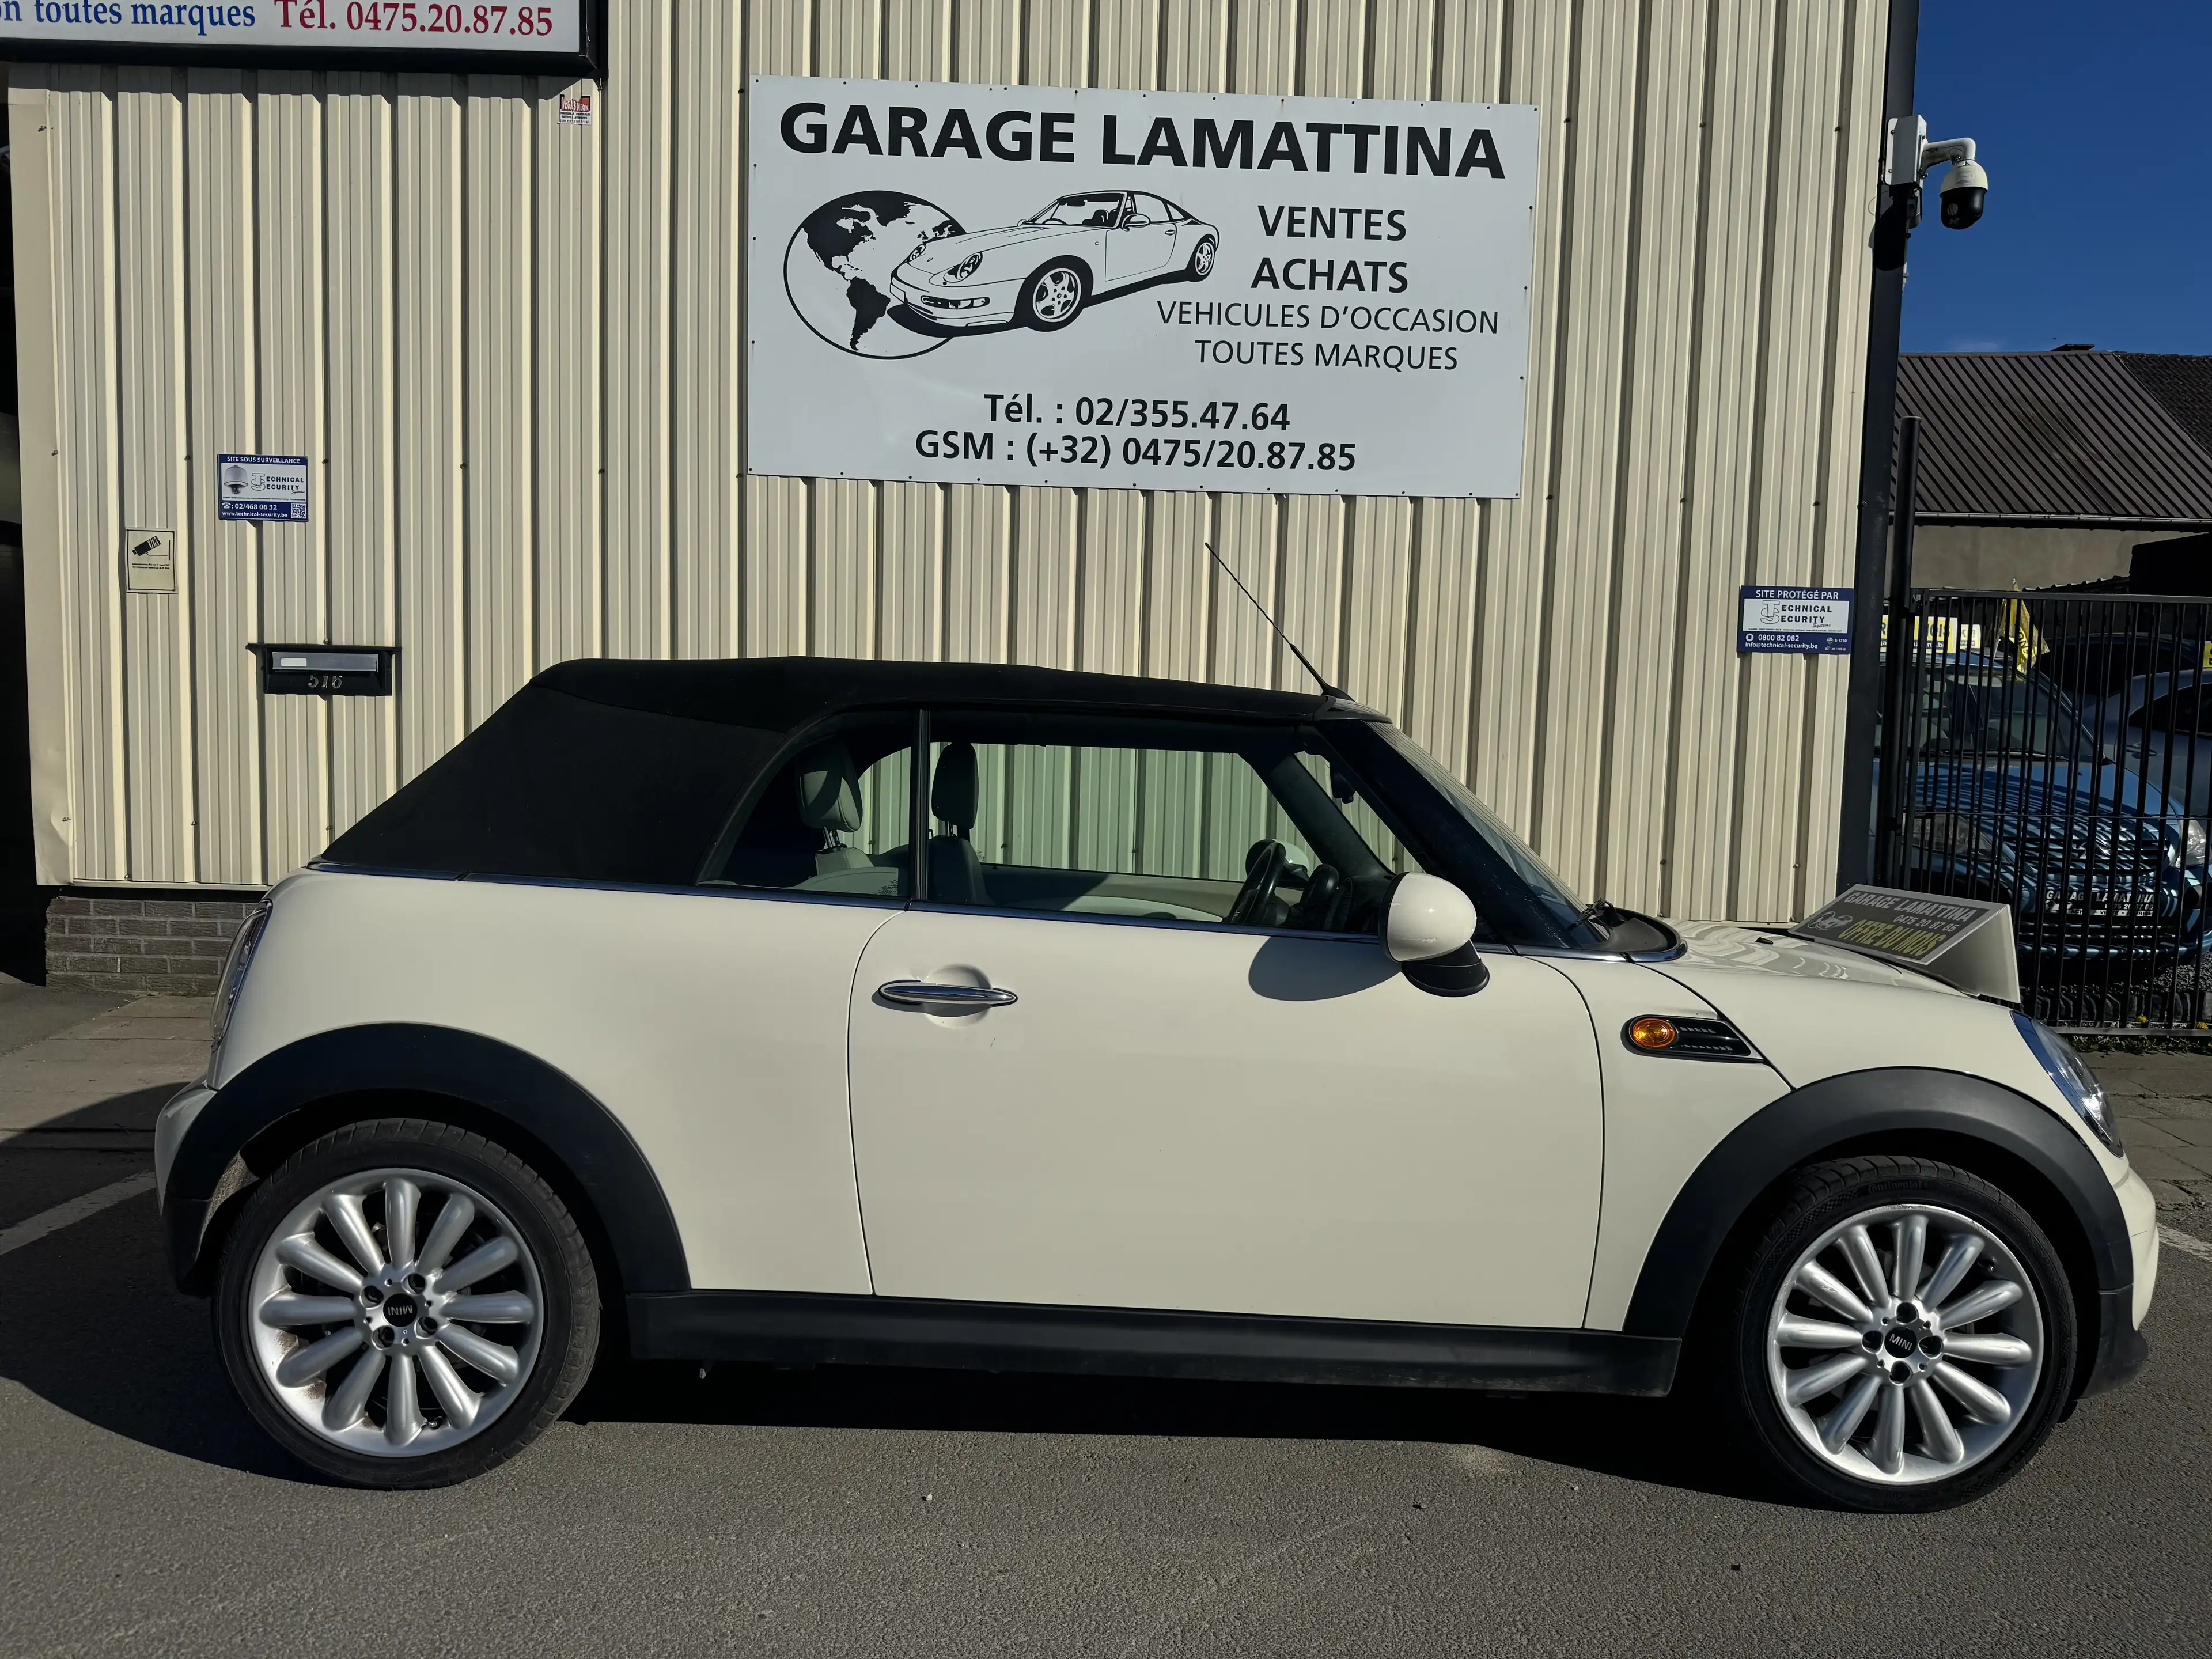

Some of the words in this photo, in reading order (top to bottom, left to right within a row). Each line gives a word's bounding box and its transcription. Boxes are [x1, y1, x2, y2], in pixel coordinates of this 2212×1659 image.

[35, 0, 122, 24] toutes
[131, 3, 255, 36] marques
[274, 0, 336, 29] Tél.
[346, 1, 553, 36] 0475.20.87.85
[781, 103, 1075, 162] GARAGE
[1103, 115, 1505, 179] LAMATTINA
[1258, 206, 1406, 241] VENTES
[1251, 258, 1408, 293] ACHATS
[1157, 301, 1309, 328] VEHICULES
[1321, 306, 1498, 334] D'OCCASION
[1195, 340, 1304, 365] TOUTES
[1315, 344, 1457, 372] MARQUES
[984, 393, 1043, 423] Tél.
[1075, 397, 1290, 431] 02/355.47.64
[915, 430, 993, 460] GSM
[1027, 433, 1111, 469] (+32)
[1123, 438, 1355, 471] 0475/20.87.85
[1756, 590, 1775, 598] SITE
[1777, 589, 1819, 599] PROTÉGÉ
[1821, 592, 1839, 600] PAR
[1844, 892, 1900, 909] GARAGE
[1894, 899, 1977, 922] LAMATTINA
[2046, 891, 2088, 901] GAAG
[1838, 919, 1895, 945] OFFRE
[1873, 926, 1914, 949] DU
[1893, 914, 1916, 925] 0475
[1915, 918, 1929, 927] 20
[1929, 921, 1943, 930] 87
[1942, 923, 1960, 933] 85
[1892, 930, 1946, 956] MOIS
[388, 1305, 413, 1316] MINI
[1889, 1334, 1912, 1351] MINI
